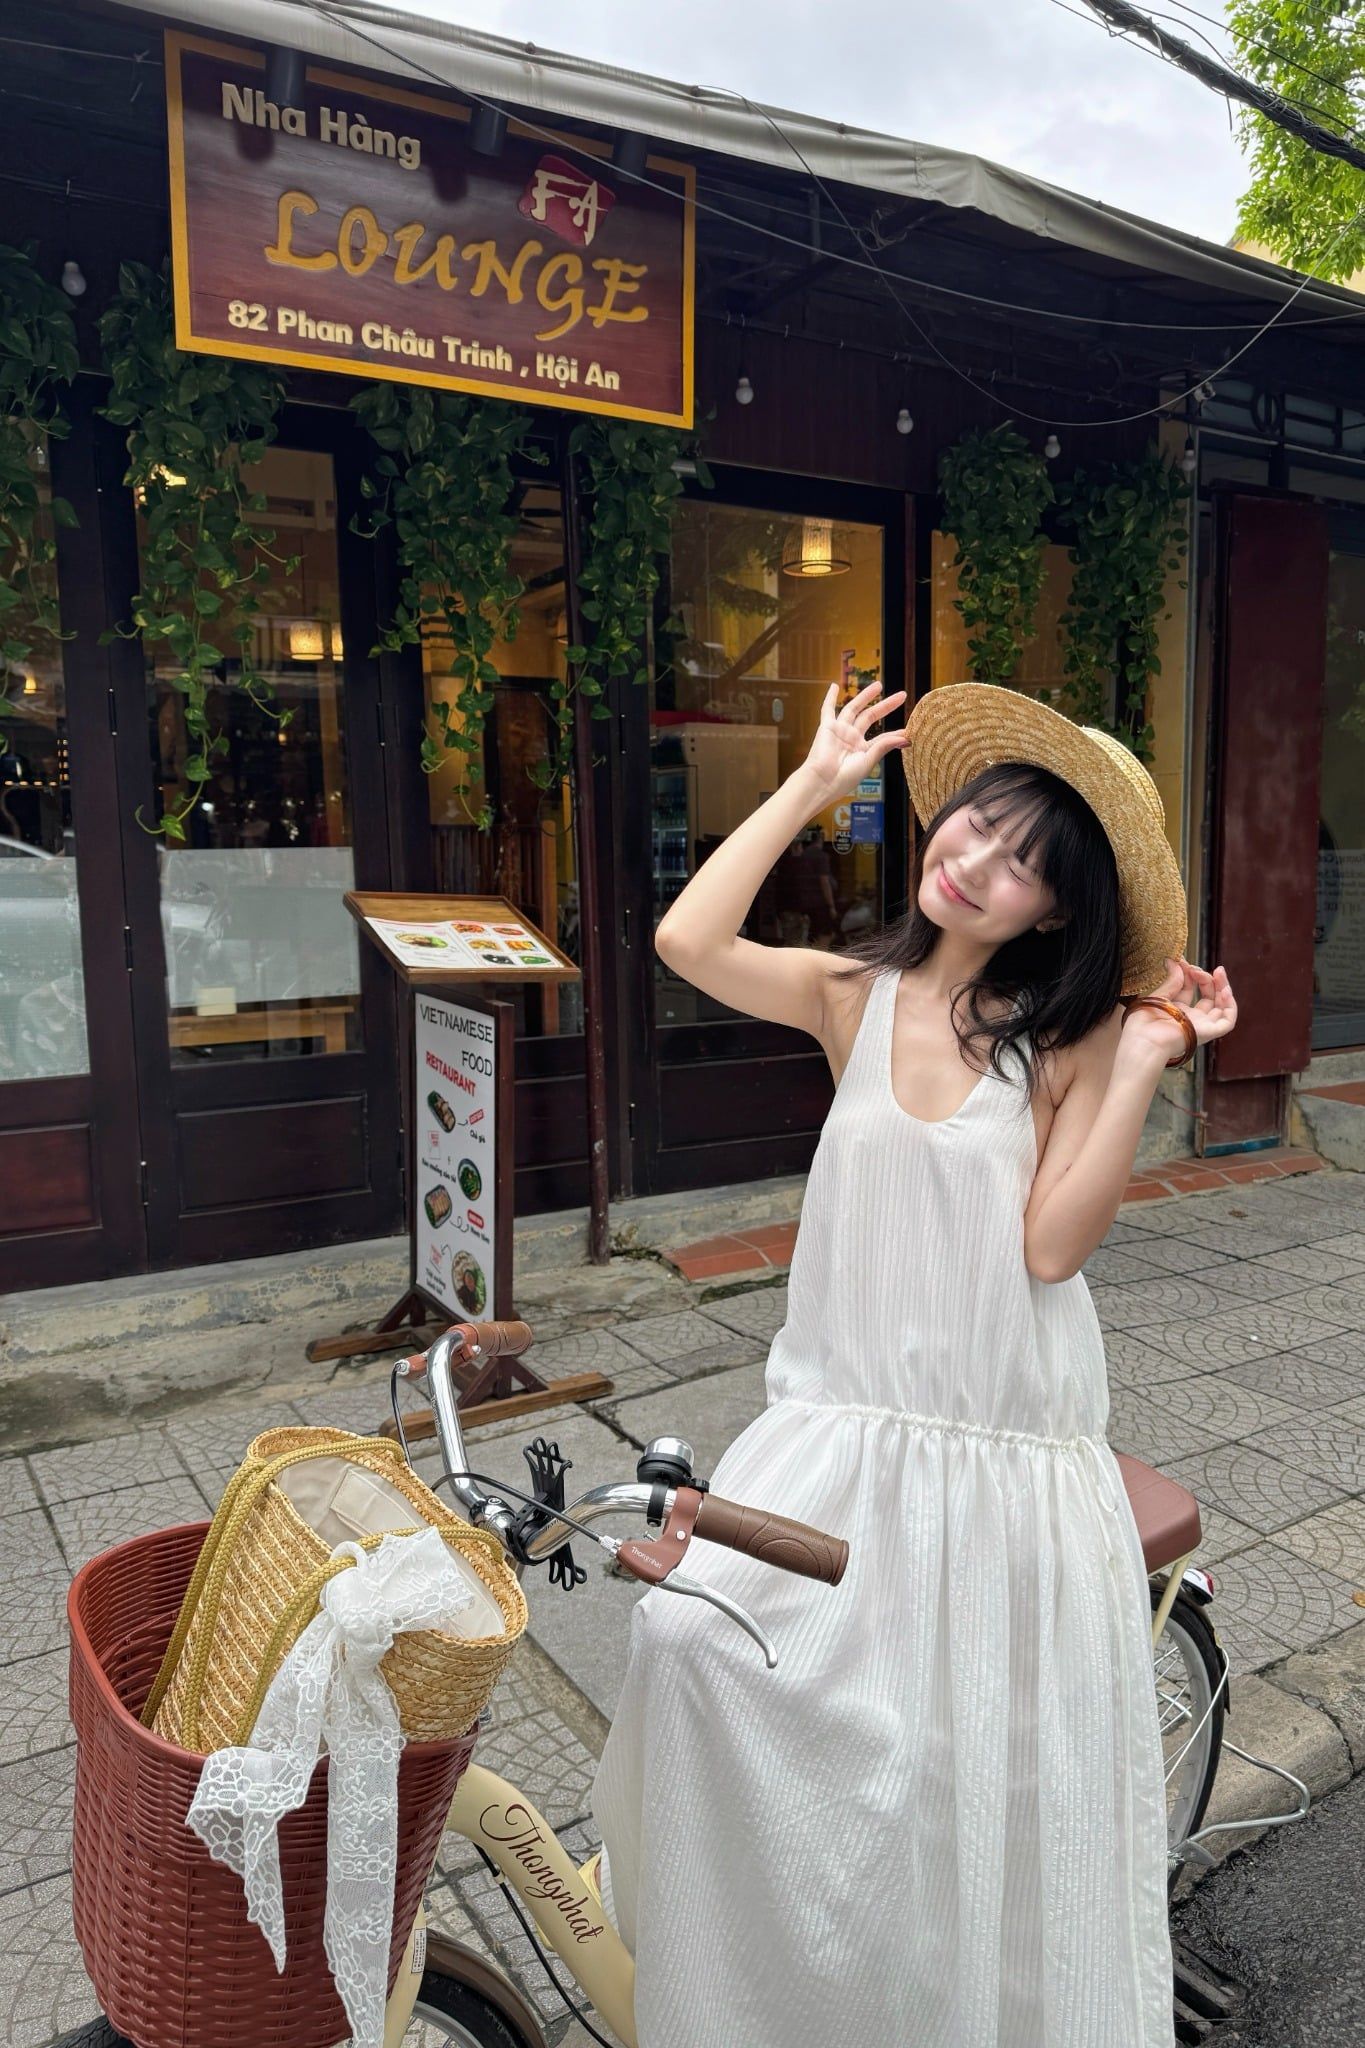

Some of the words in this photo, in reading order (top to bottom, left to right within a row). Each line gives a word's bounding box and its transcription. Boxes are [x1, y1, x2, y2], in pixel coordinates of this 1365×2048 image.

[319, 106, 421, 170] Hàng
[264, 190, 649, 341] LOUNGE
[228, 299, 269, 331] 82
[277, 306, 354, 345] Phan
[361, 321, 435, 359] Châu
[442, 335, 513, 372] Trinh
[536, 351, 578, 389] Hội
[584, 361, 620, 390] An
[420, 1003, 493, 1044] VIETNAMESE
[426, 1050, 476, 1097] RESTAURANT
[461, 1050, 493, 1077] FOOD
[479, 1803, 605, 1945] Thongnhat
